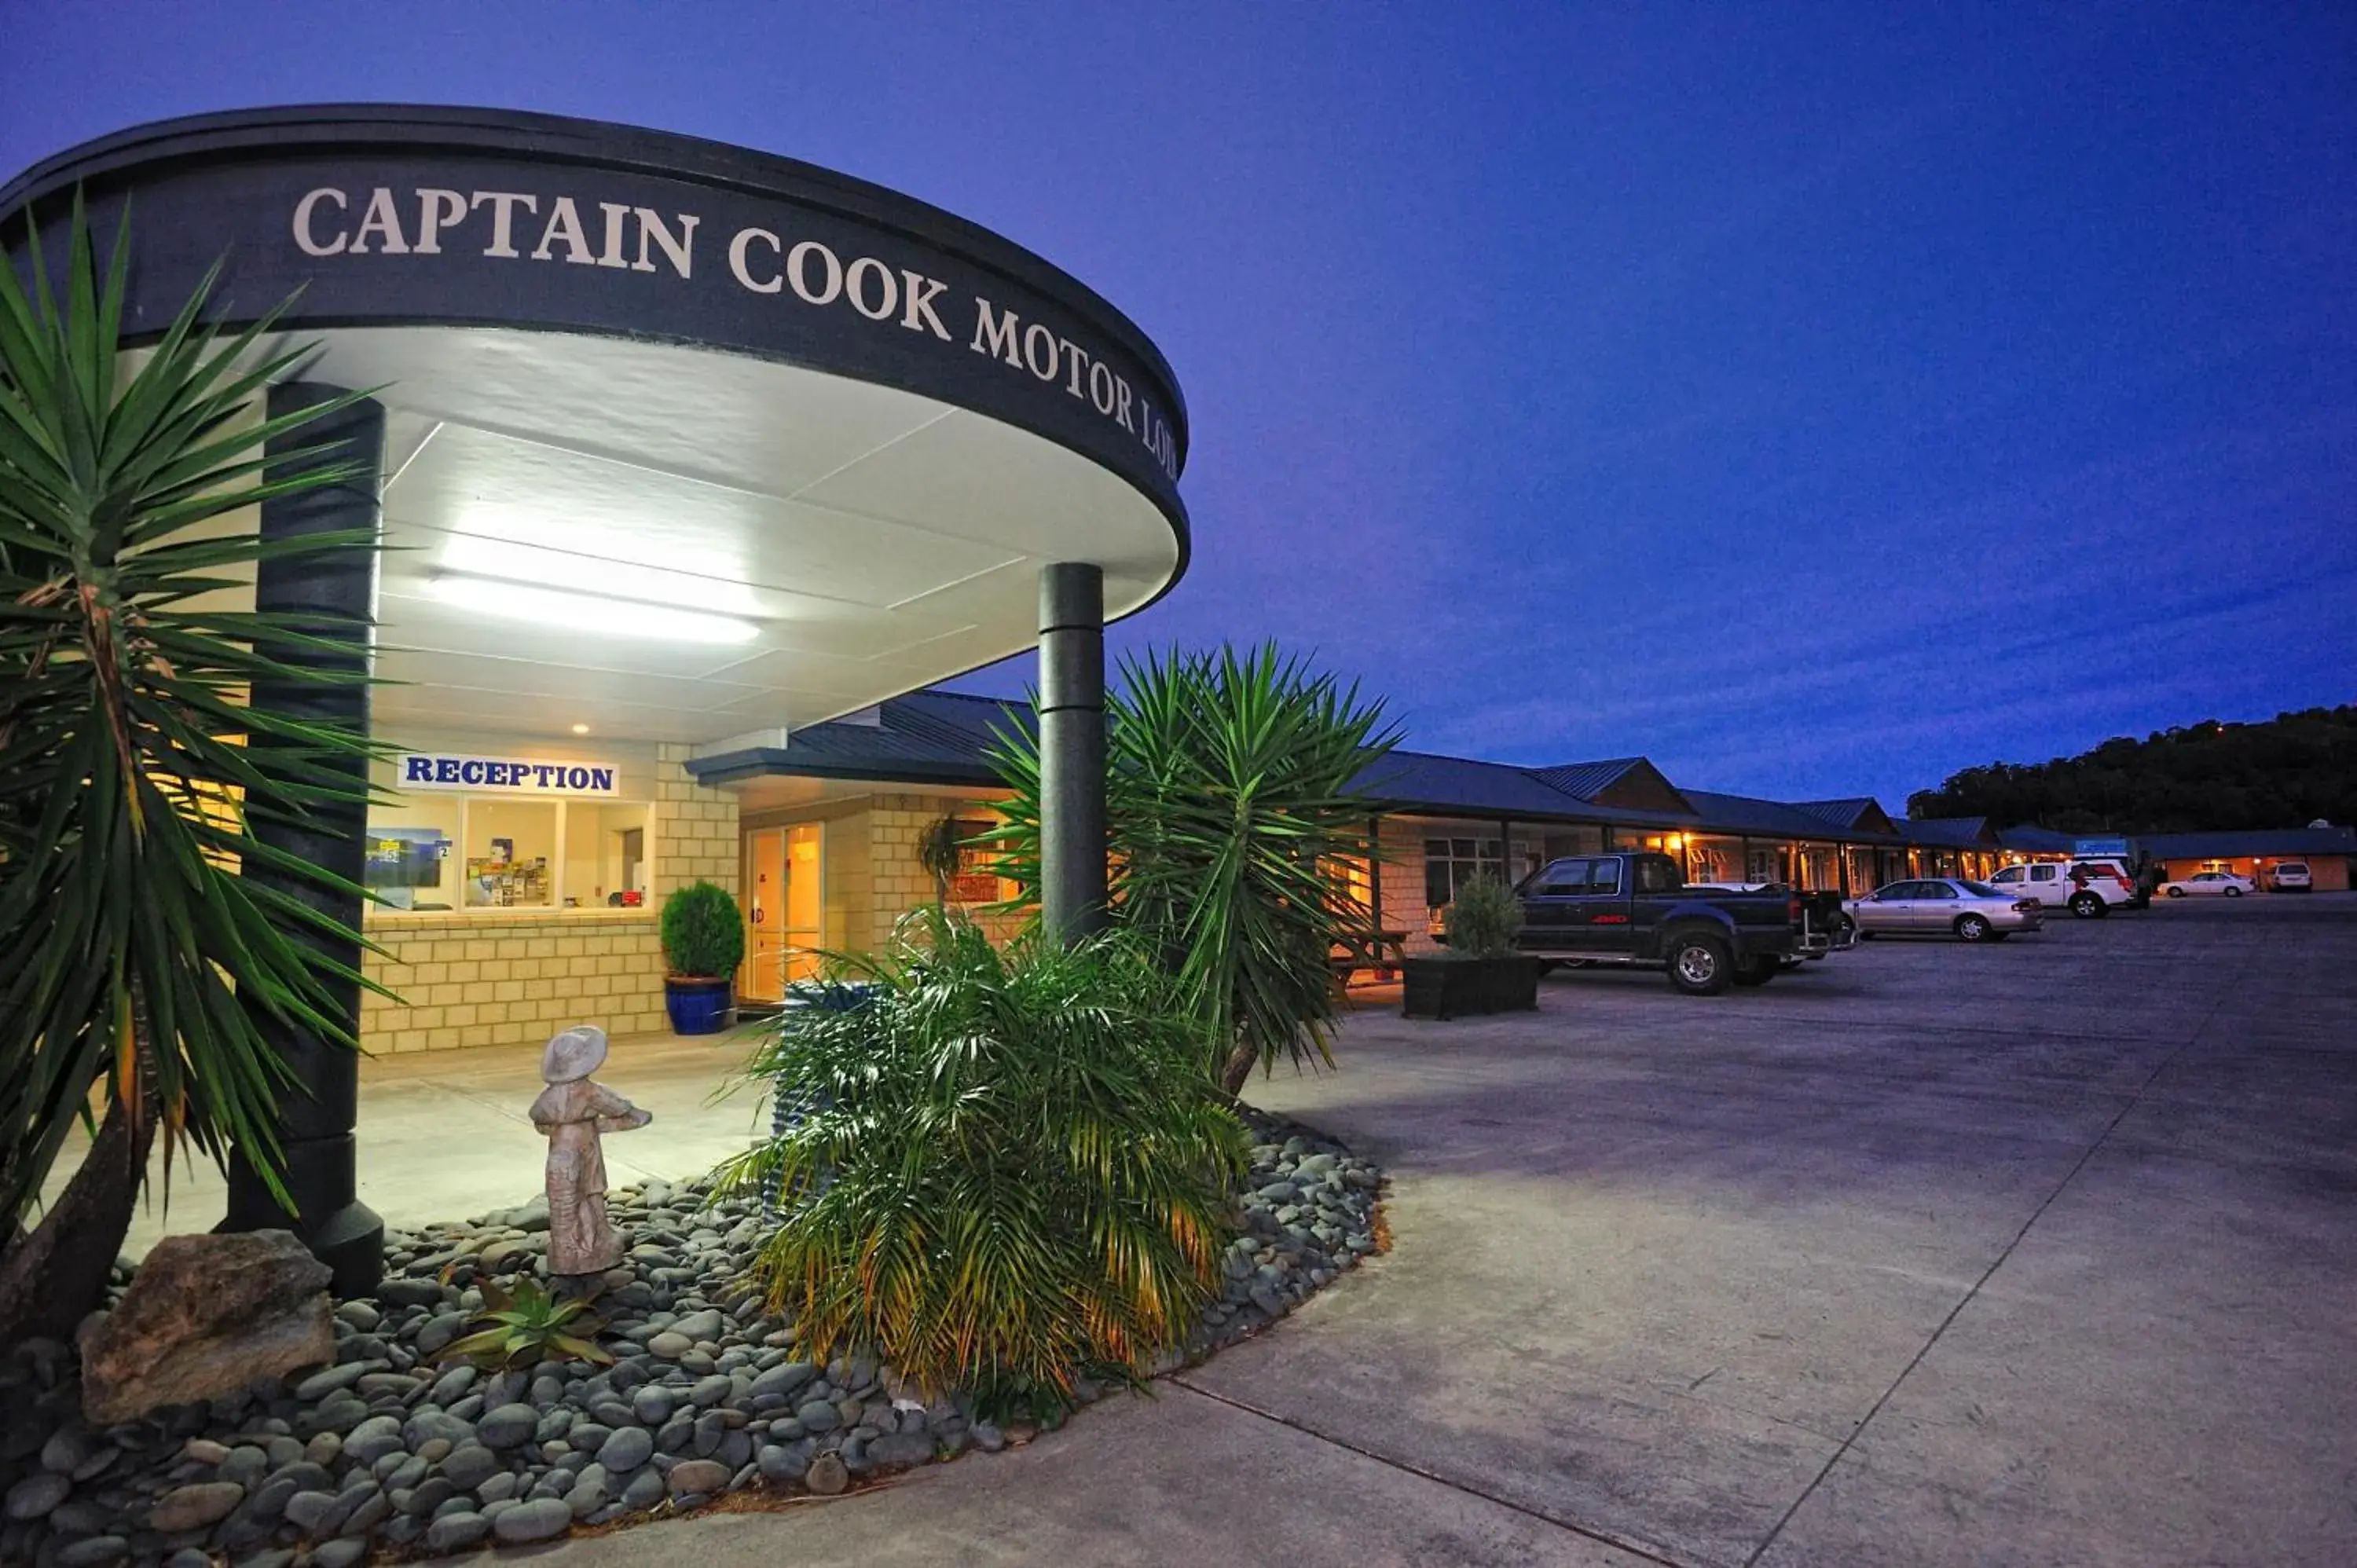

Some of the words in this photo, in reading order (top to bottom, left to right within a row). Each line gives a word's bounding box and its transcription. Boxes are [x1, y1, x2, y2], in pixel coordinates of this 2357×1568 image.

[293, 188, 700, 279] CAPTAIN
[728, 227, 952, 343] COOK
[970, 296, 1135, 434] MOTOR
[406, 757, 614, 791] RECEPTION
